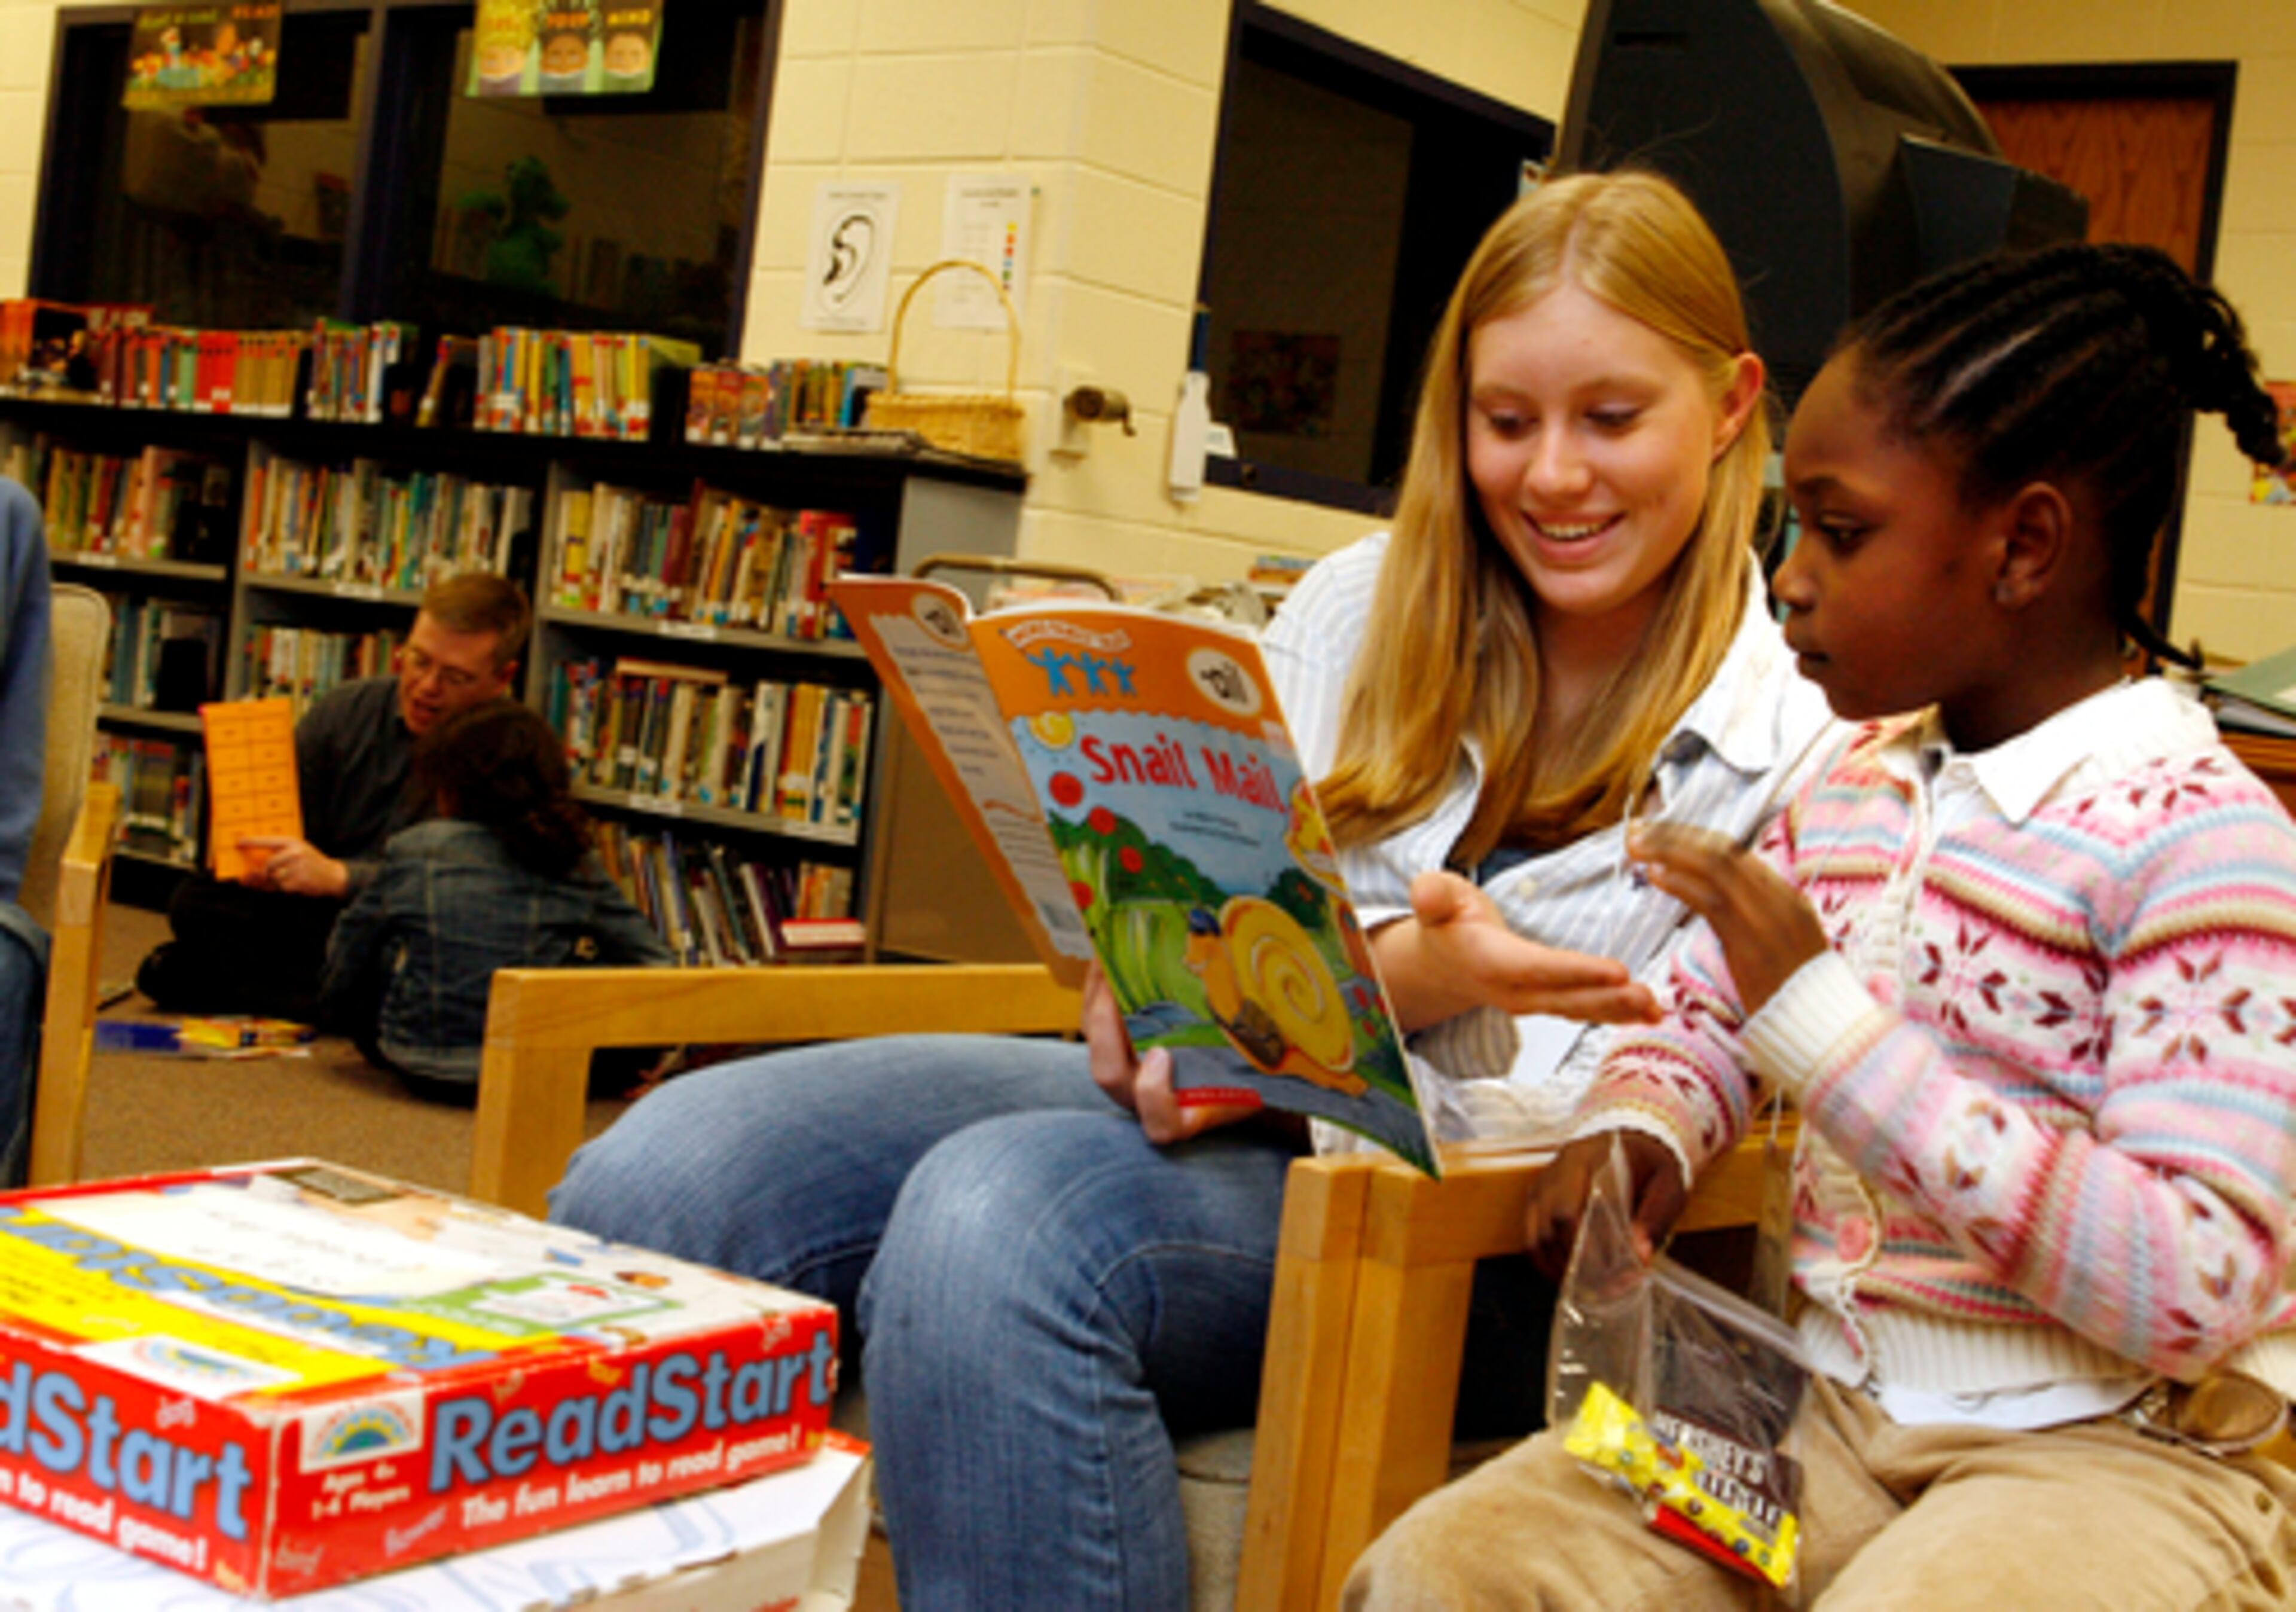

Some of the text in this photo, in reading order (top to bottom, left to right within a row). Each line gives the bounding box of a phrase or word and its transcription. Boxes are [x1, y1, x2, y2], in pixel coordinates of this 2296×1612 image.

[1080, 731, 1287, 814] Snail Mail
[428, 1330, 833, 1493] ReadStart
[17, 1471, 47, 1507] to
[50, 1490, 114, 1534] read
[117, 1516, 207, 1572] game!
[461, 1422, 802, 1529] The fun learn to read game!
